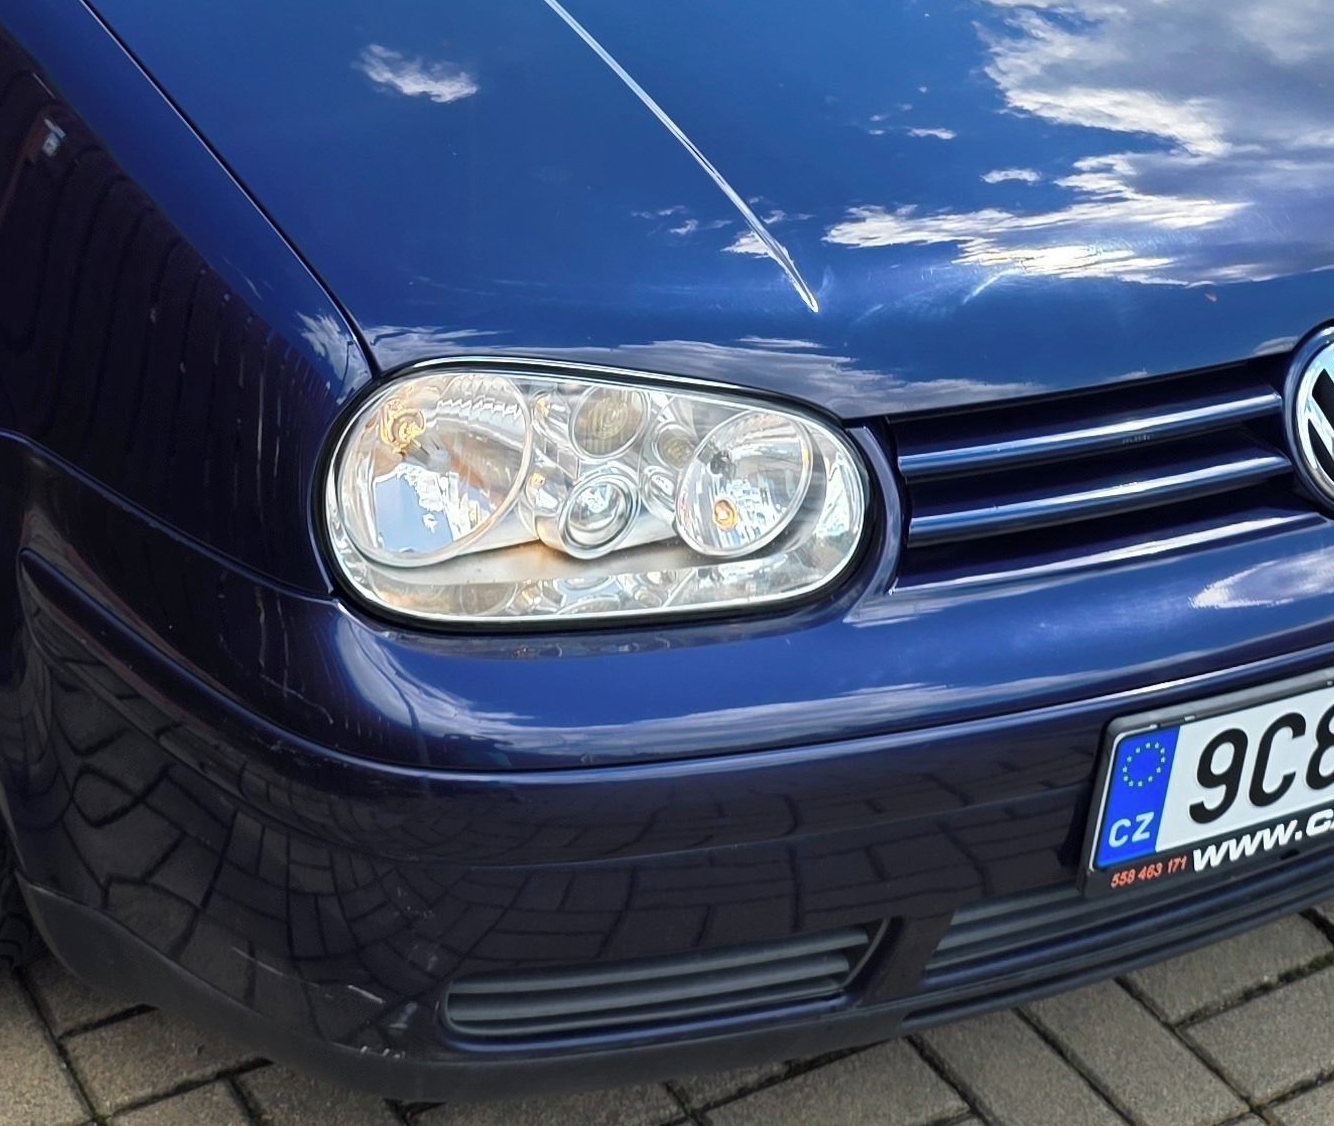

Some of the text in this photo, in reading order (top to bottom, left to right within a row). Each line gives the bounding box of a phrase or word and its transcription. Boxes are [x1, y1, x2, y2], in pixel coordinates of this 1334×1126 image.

[1108, 811, 1155, 848] CZ
[1110, 855, 1187, 889] 558 463 171
